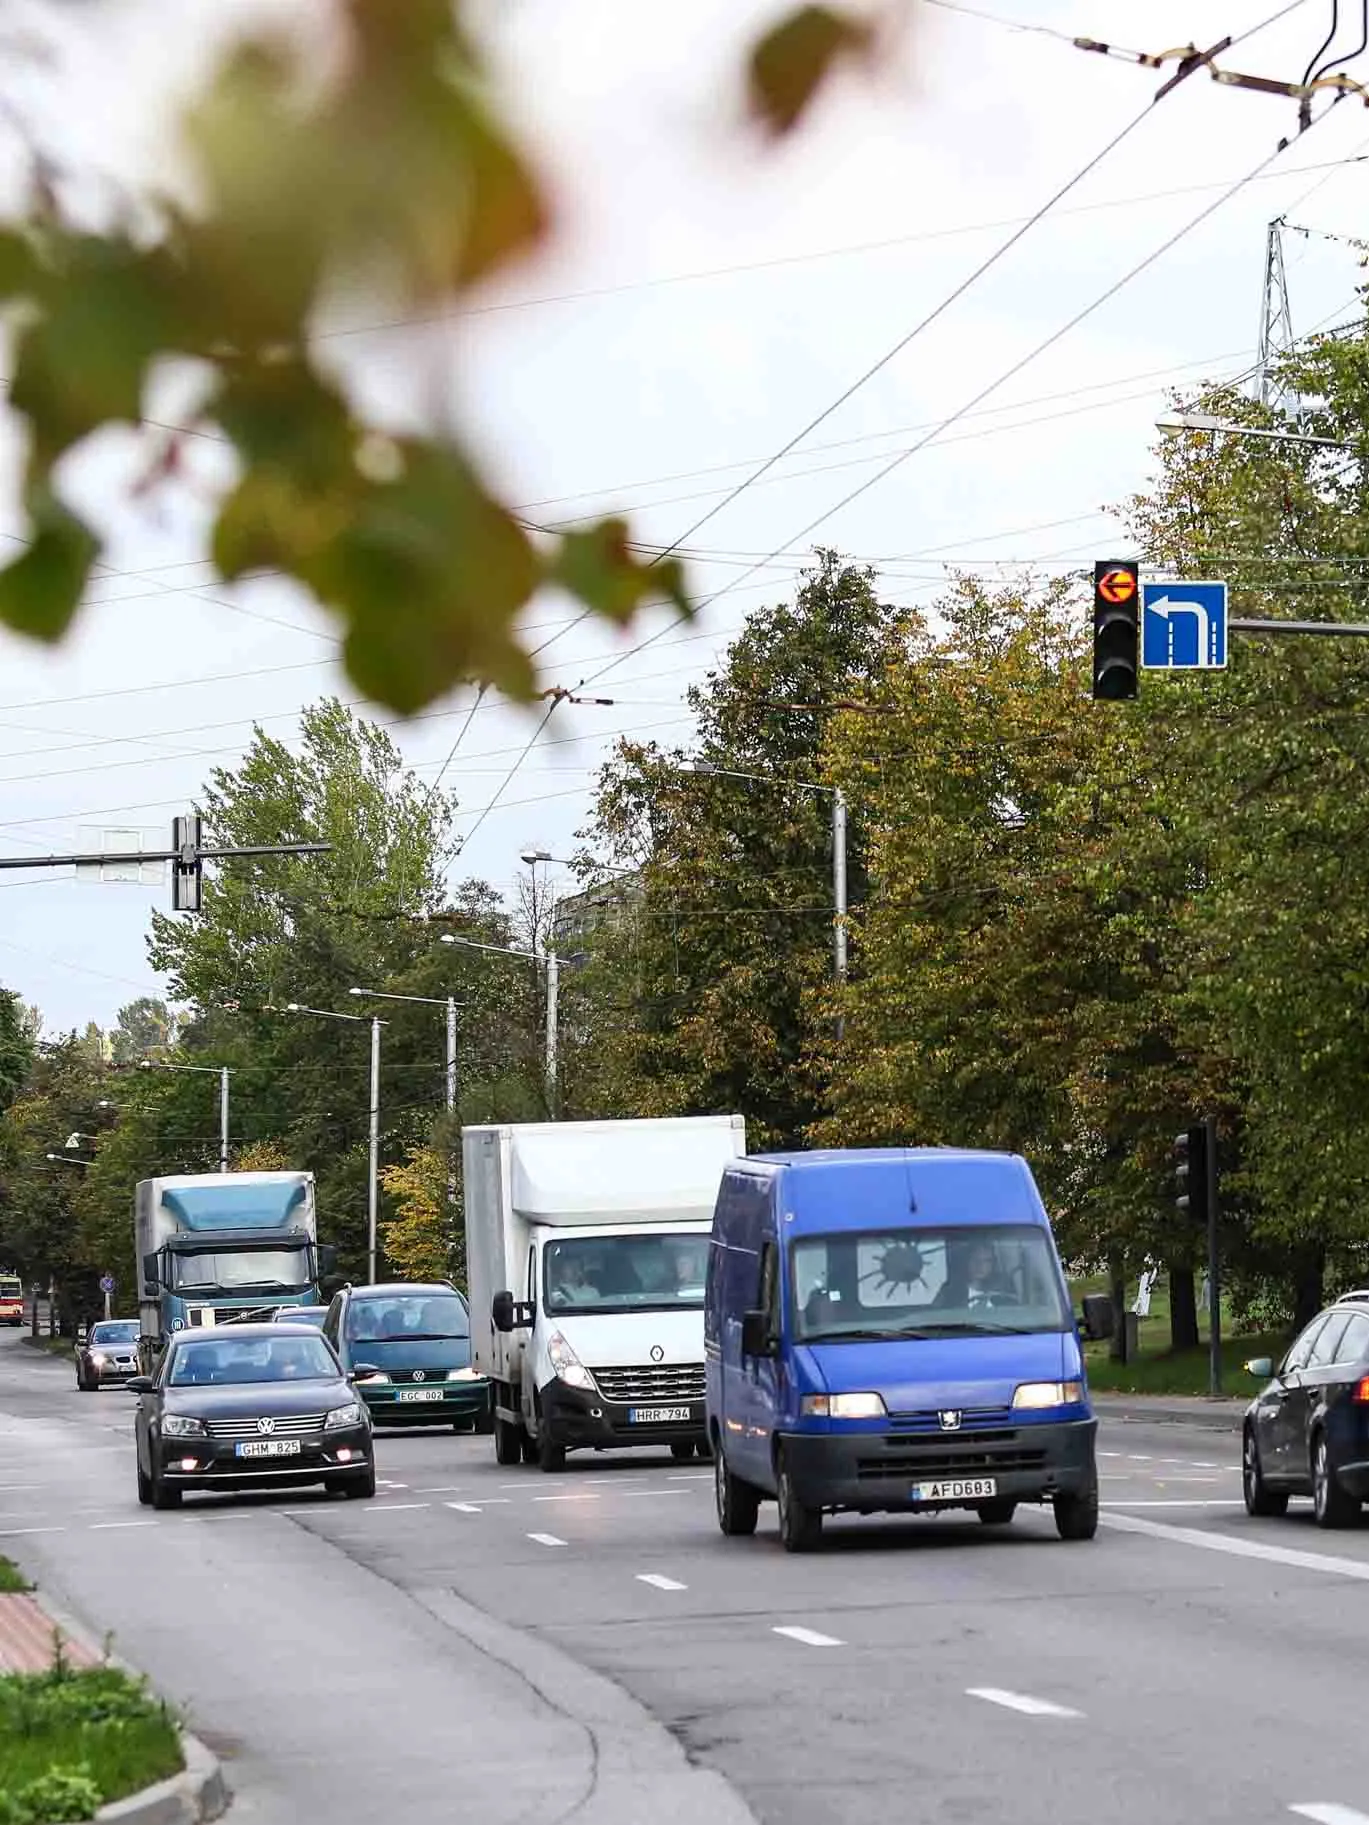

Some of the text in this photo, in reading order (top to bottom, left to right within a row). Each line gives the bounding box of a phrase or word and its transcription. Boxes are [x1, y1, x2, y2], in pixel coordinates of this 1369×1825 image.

[401, 1391, 442, 1401] EGC 002
[637, 1408, 688, 1421] HRR 794
[243, 1441, 299, 1455] GHM 825
